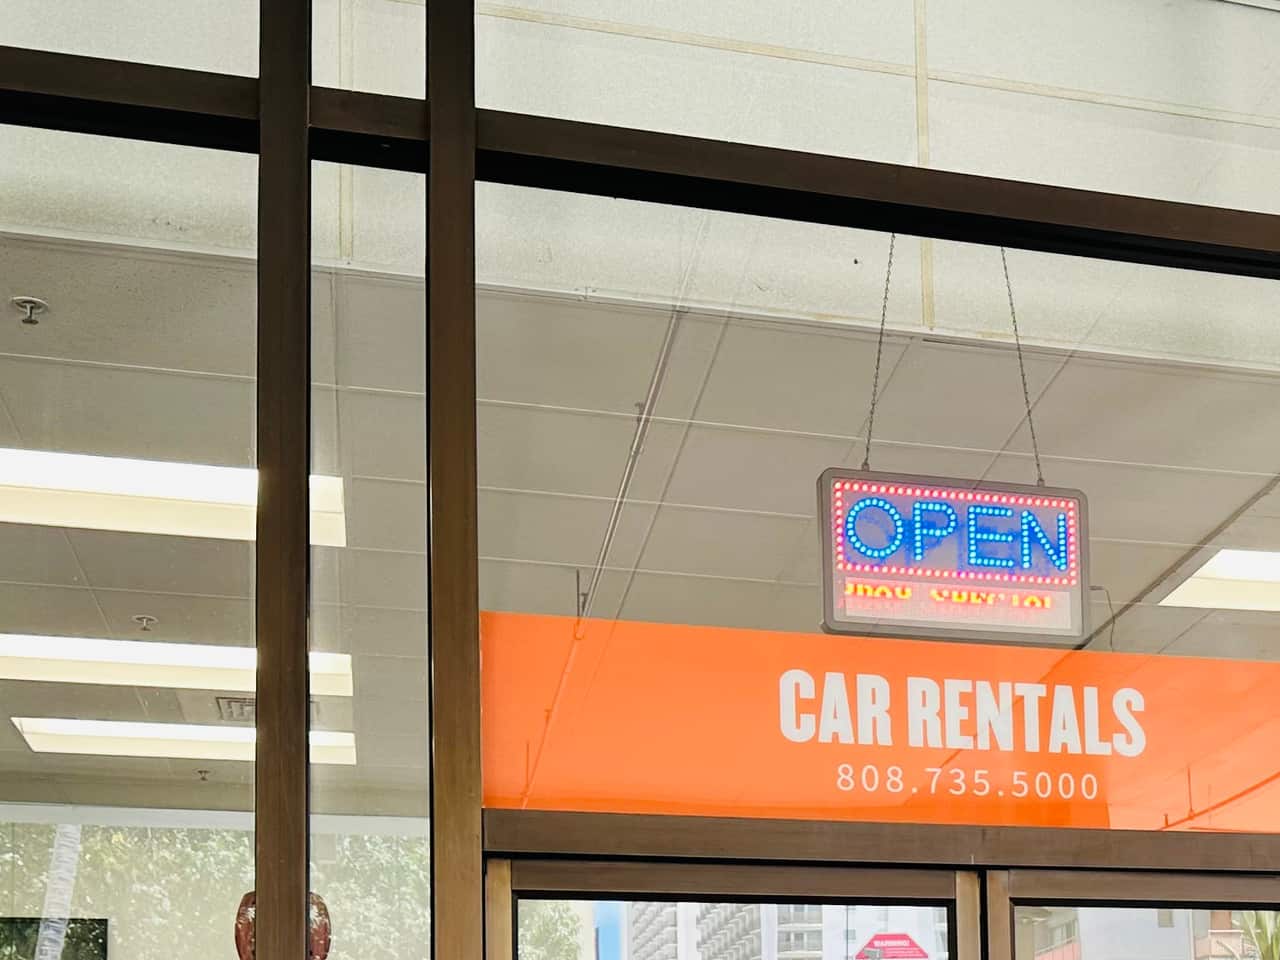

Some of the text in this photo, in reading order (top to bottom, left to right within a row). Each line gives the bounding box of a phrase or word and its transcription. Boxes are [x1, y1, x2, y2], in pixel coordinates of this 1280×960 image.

[845, 497, 1068, 572] OPEN
[778, 668, 1147, 758] CAR RENTALS
[836, 763, 1099, 802] 808.735.5000
